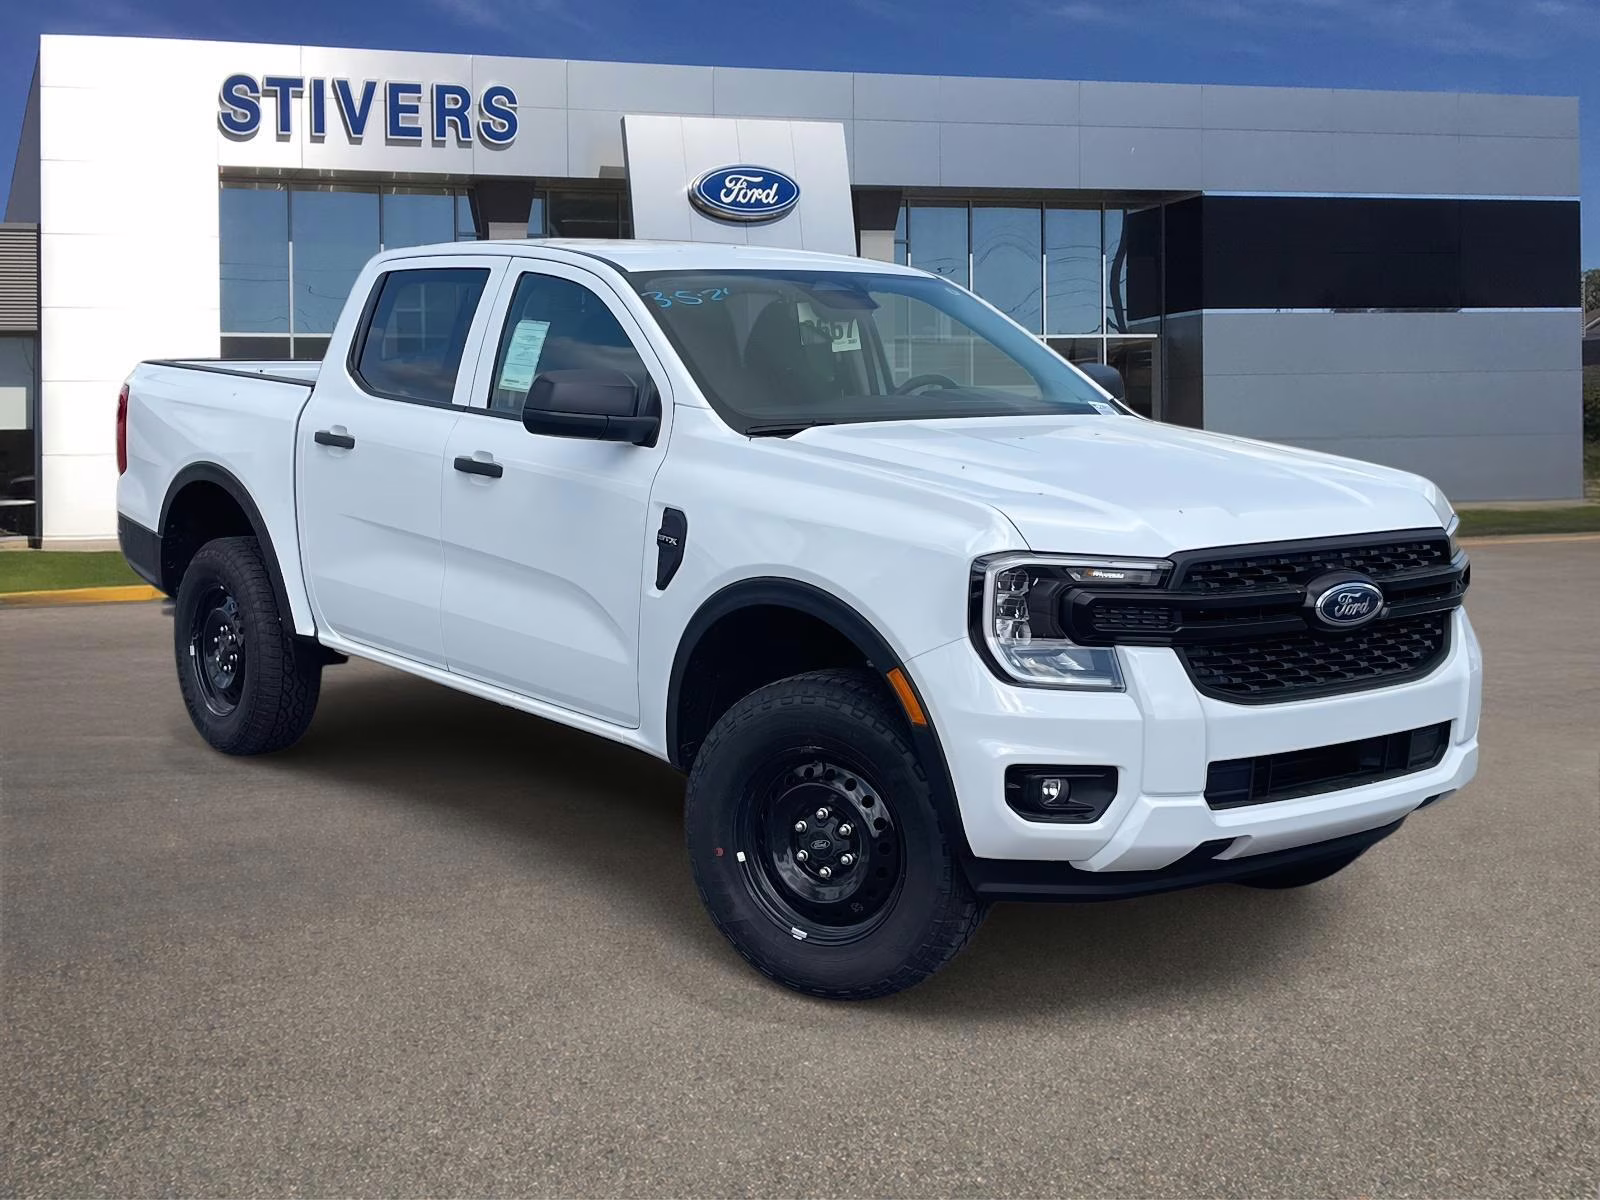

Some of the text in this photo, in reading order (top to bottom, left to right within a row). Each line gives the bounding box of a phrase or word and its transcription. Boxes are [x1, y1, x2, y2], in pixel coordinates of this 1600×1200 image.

[218, 73, 519, 146] STIVERS
[720, 175, 778, 206] Ford
[1335, 593, 1371, 617] Ford
